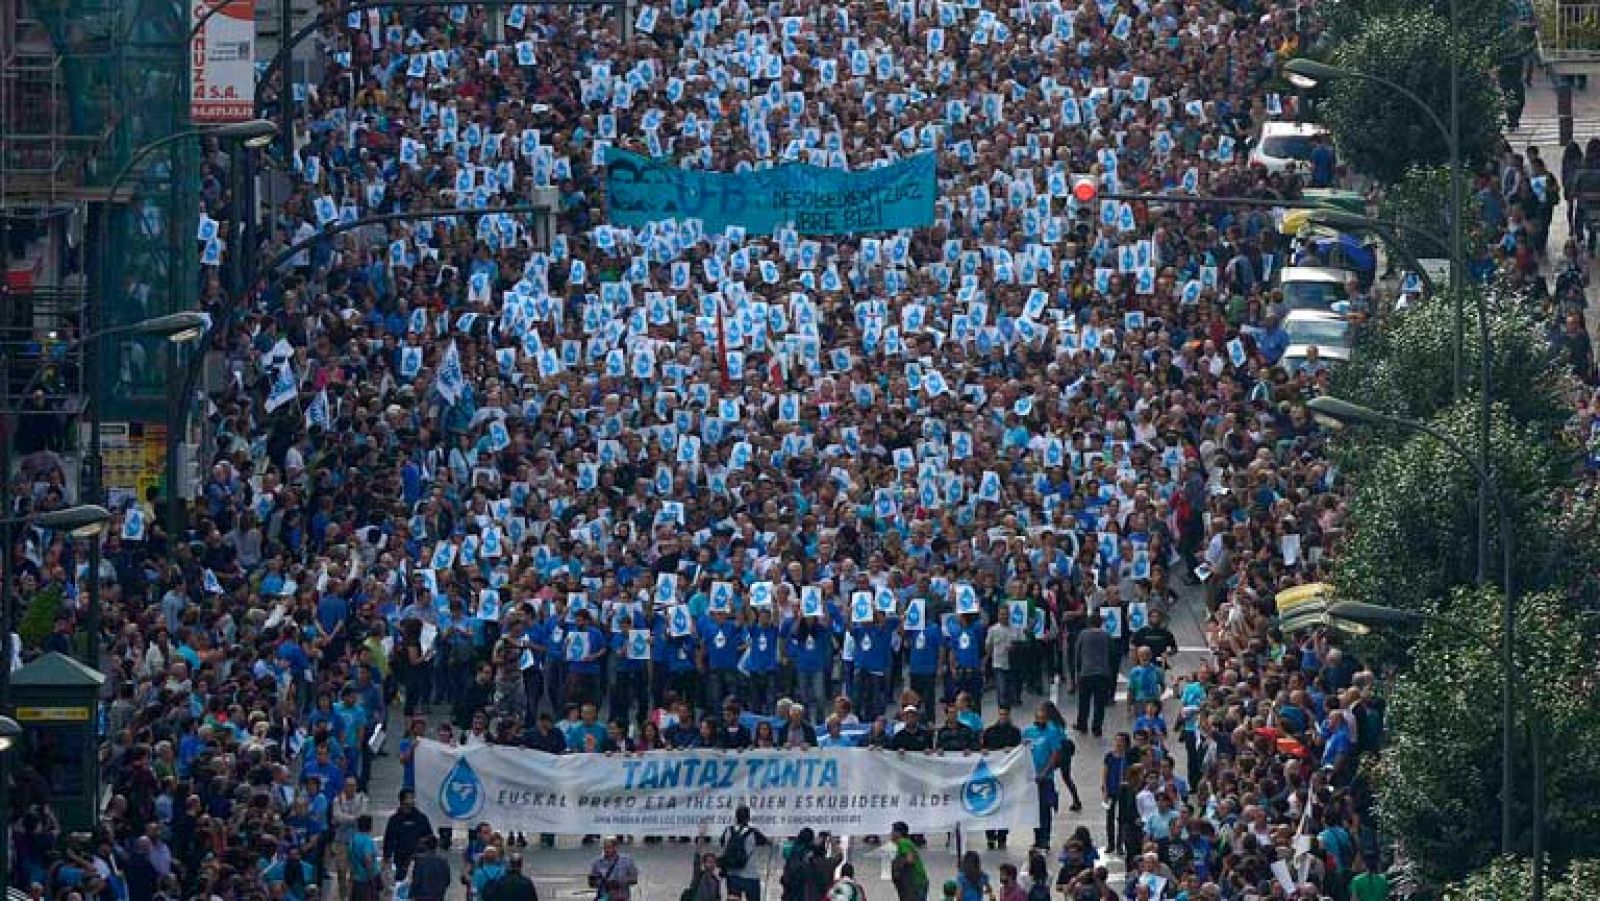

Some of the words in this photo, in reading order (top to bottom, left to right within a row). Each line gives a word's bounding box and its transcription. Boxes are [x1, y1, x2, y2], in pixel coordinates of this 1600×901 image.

[622, 758, 741, 790] TANTAZ
[745, 758, 839, 789] TANTA
[498, 789, 566, 808] EUSKAL
[578, 795, 636, 808] PRESO
[645, 796, 677, 810] ETA
[795, 793, 899, 809] ESKUBIDEEN
[908, 792, 952, 808] ALDE
